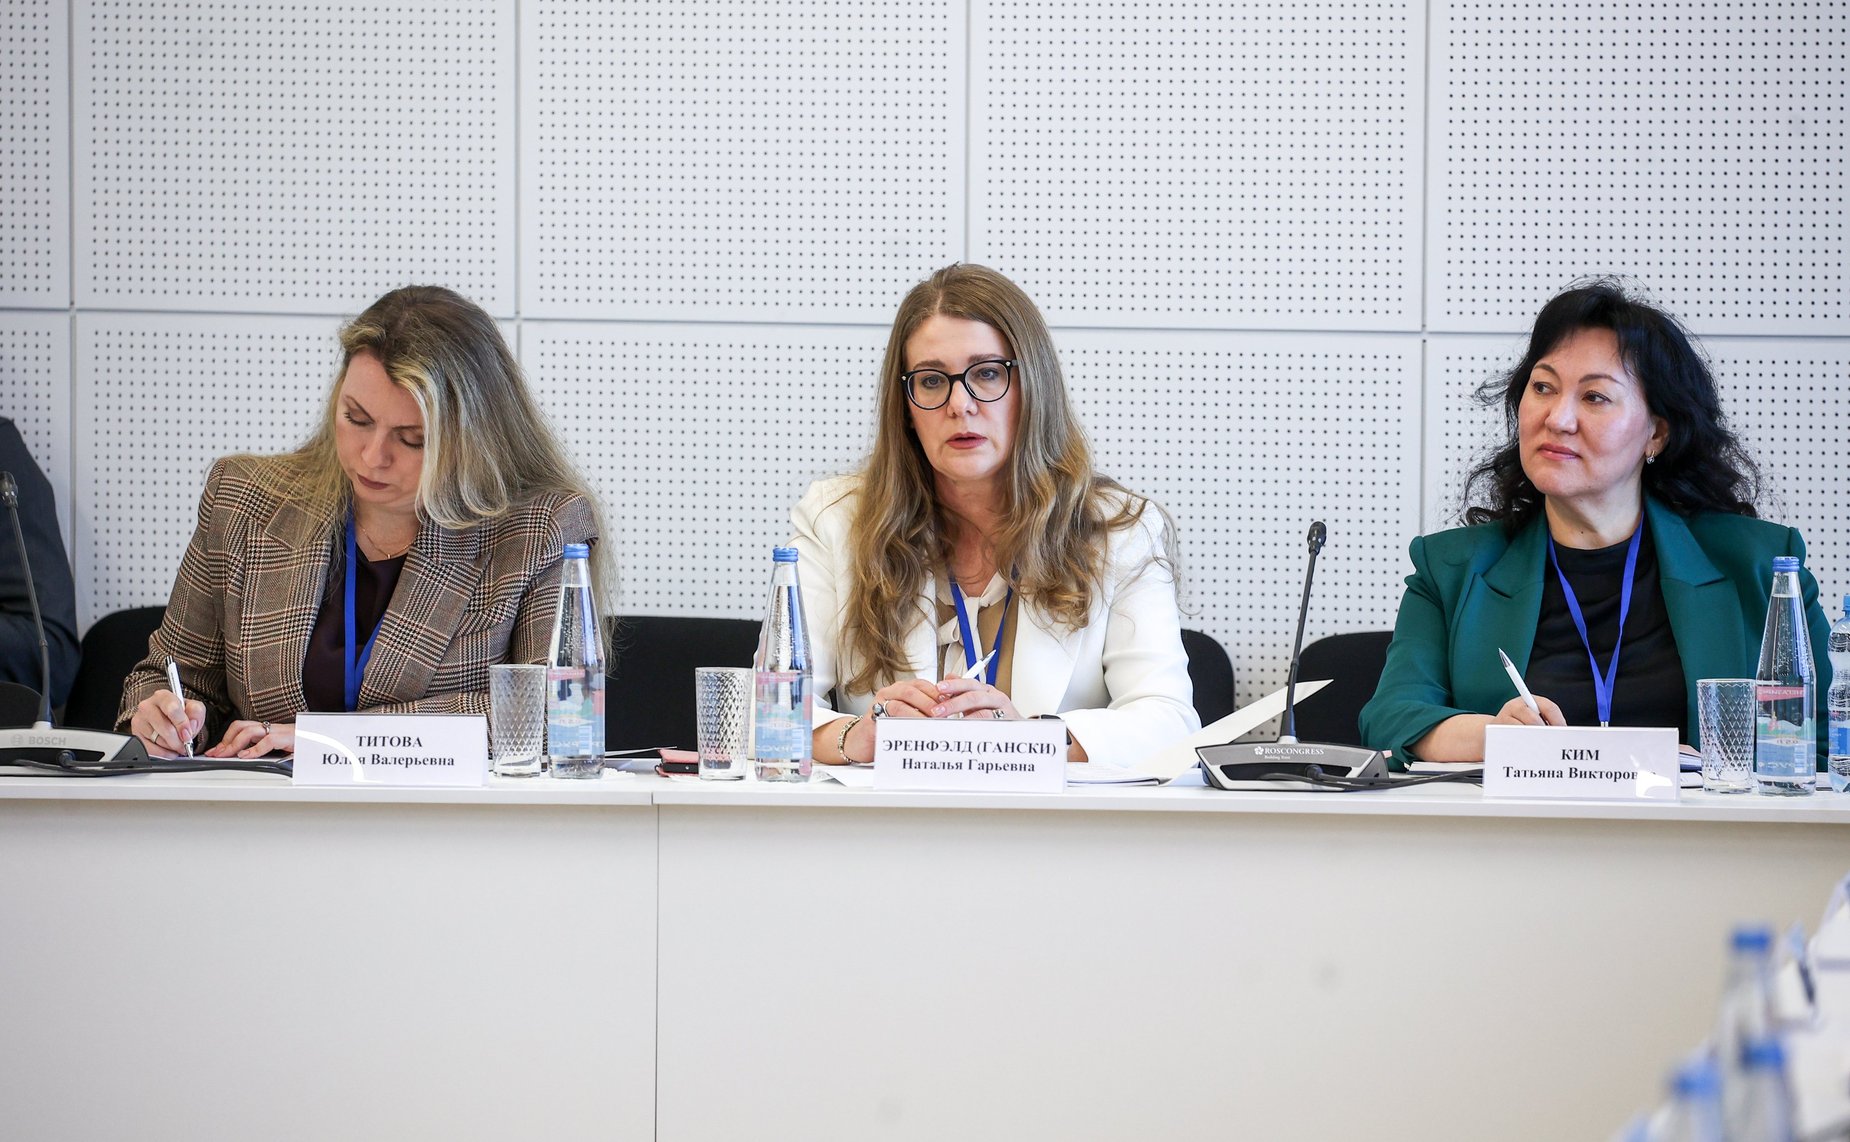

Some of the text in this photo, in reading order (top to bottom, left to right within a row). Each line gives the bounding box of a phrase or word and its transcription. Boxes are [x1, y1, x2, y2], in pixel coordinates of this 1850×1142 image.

[28, 736, 67, 746] BOSCH
[355, 735, 423, 748] ТИТОВА
[883, 740, 1057, 756] ЭРЕНФЭЛД (ГАНСКИ)
[1264, 747, 1325, 755] ROSCONGRESS
[1561, 748, 1600, 761] КИМ
[322, 753, 455, 769] Юля Валерьевна
[902, 758, 1035, 774] Наталья Гарьевна
[1502, 766, 1657, 783] Татьяна Викторов
